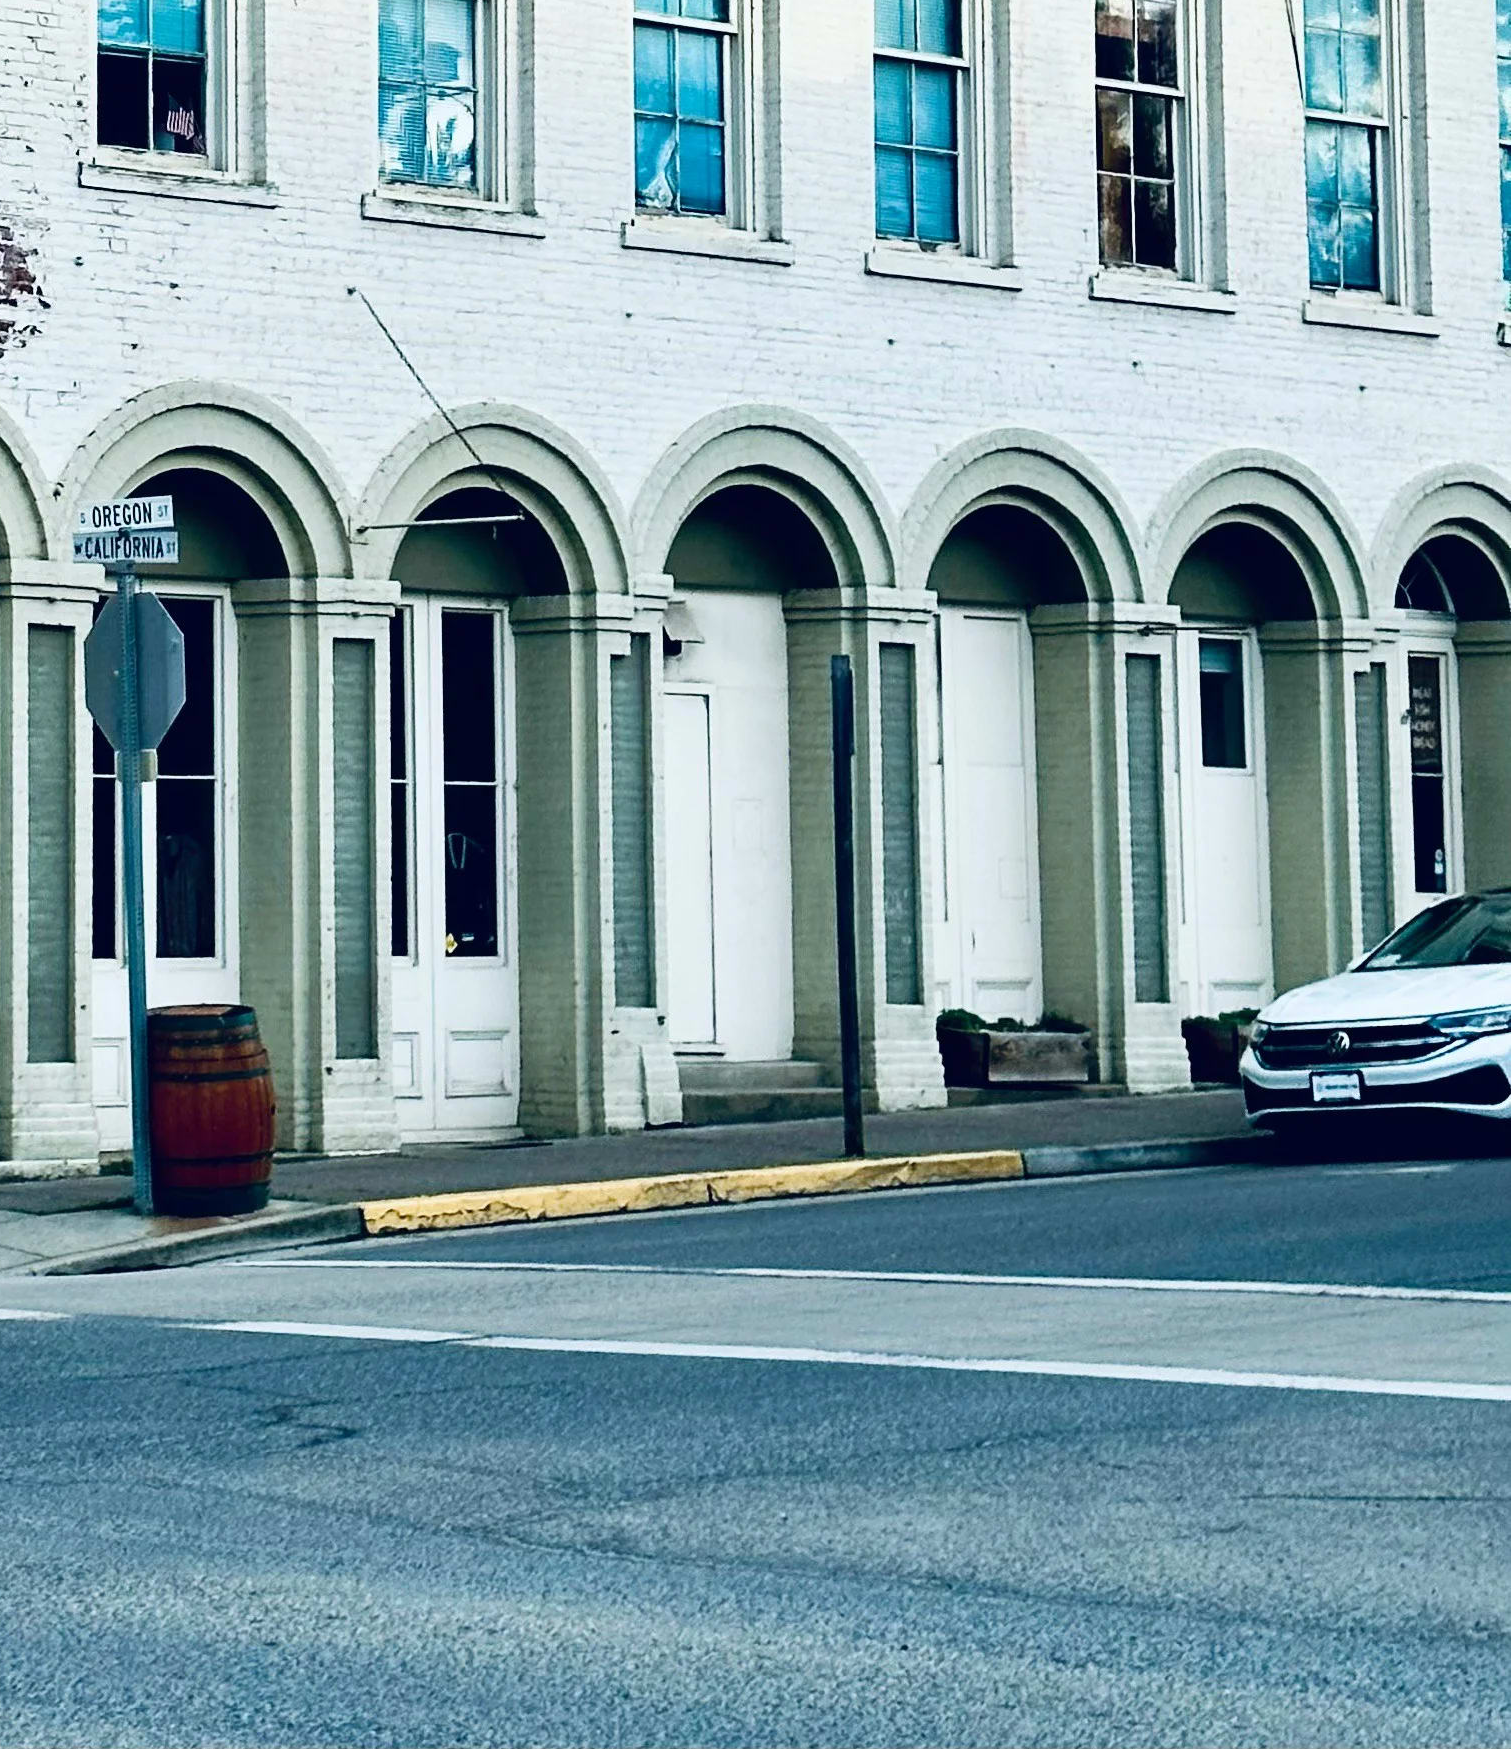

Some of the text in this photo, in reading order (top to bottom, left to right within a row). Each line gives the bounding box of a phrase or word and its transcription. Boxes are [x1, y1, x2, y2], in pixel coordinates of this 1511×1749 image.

[80, 502, 169, 528] S OREGON ST
[85, 536, 164, 559] CALIFORNIA
[166, 541, 176, 555] ST
